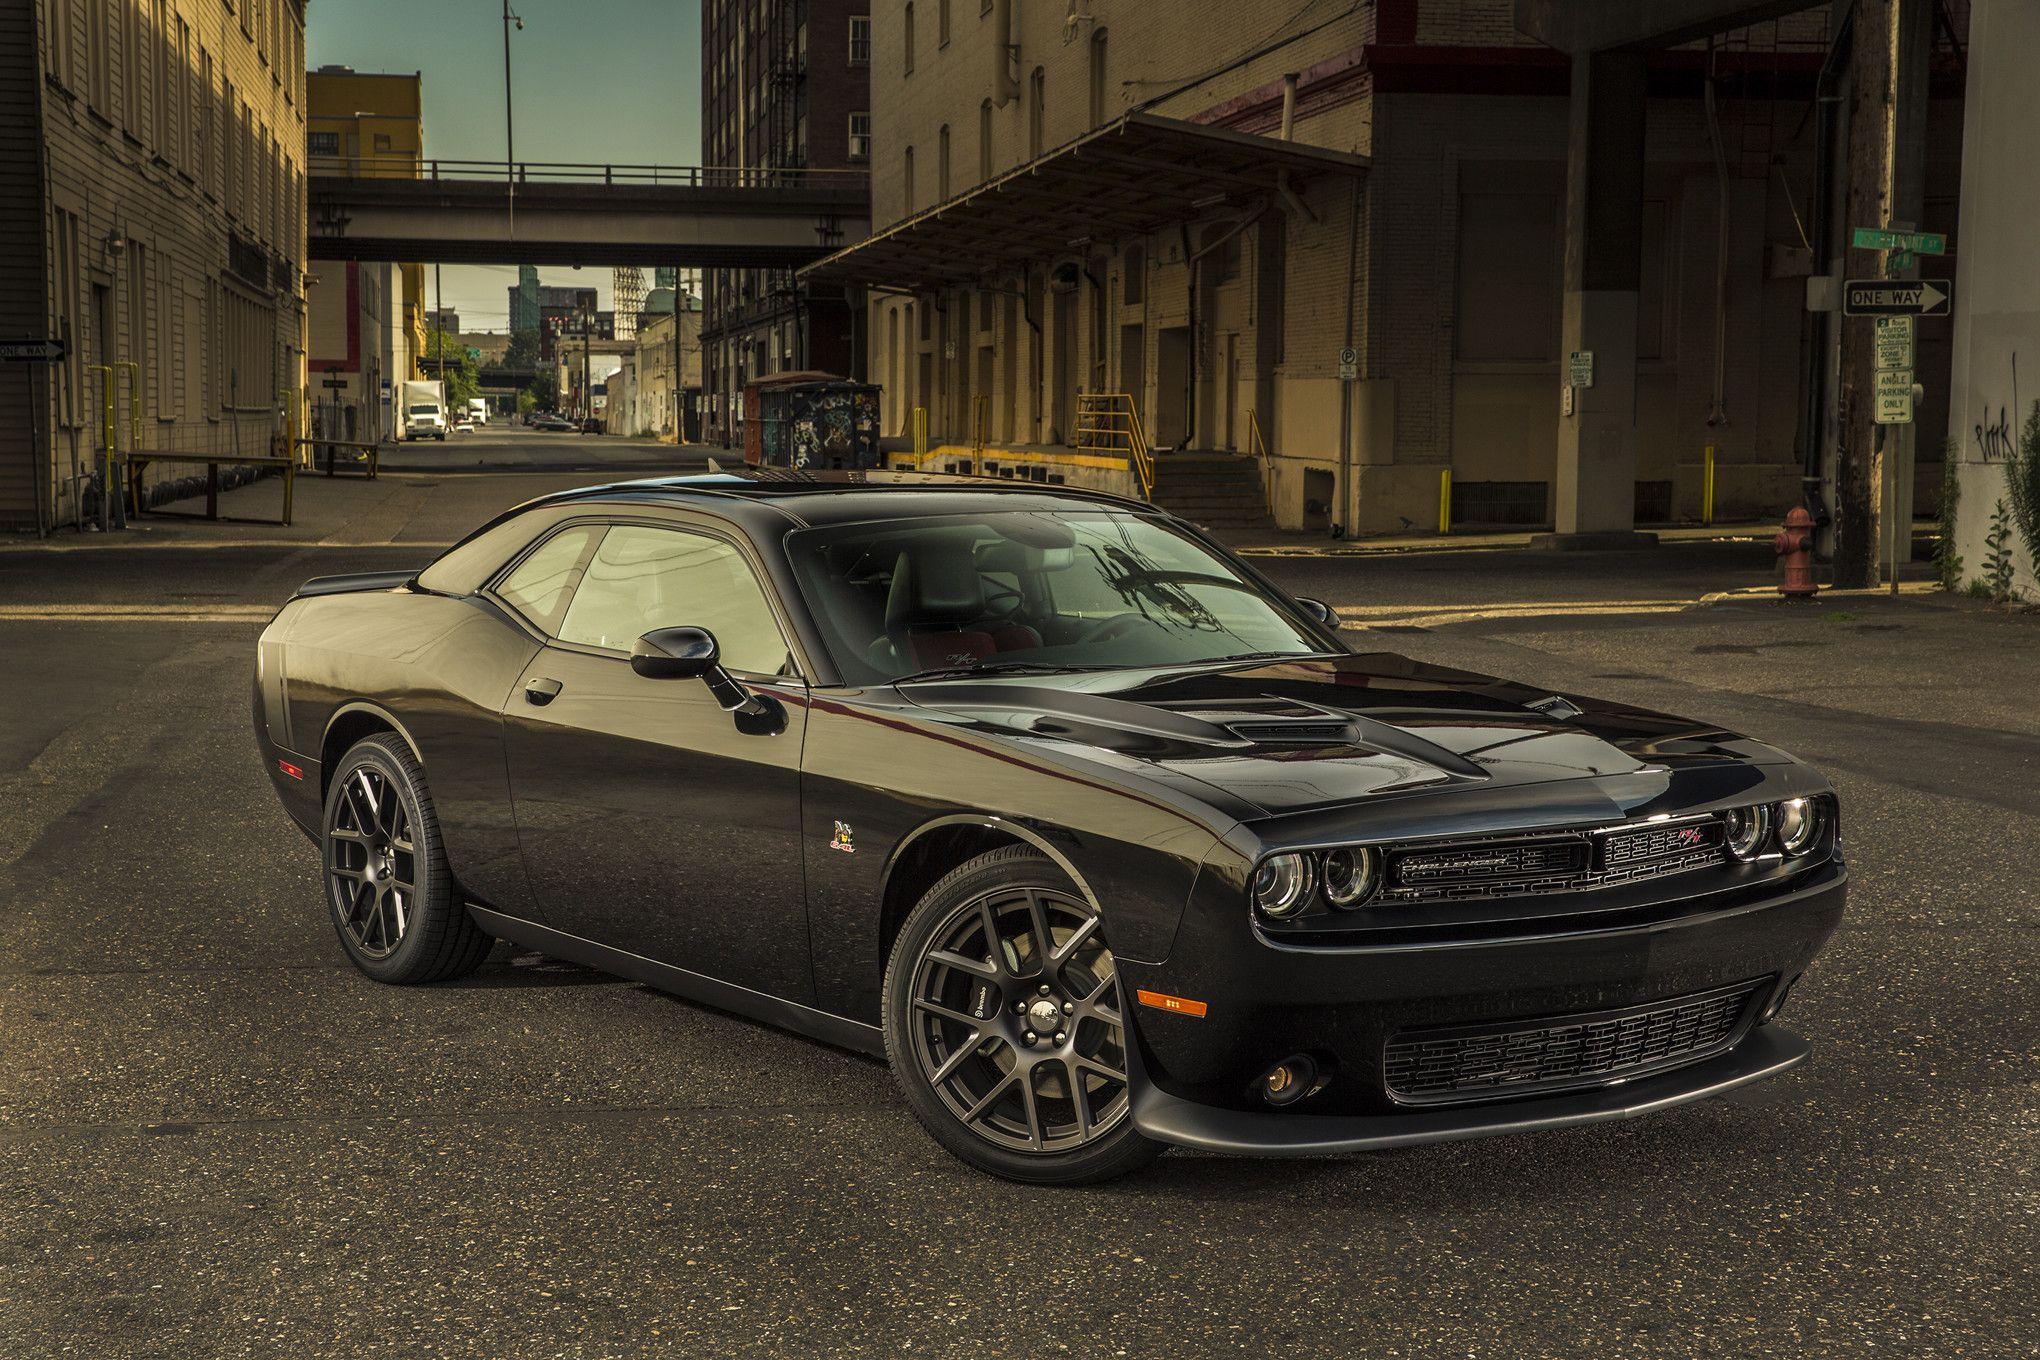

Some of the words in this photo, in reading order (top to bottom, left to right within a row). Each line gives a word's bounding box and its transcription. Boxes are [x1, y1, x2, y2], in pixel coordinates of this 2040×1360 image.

[1853, 291, 1883, 304] ONE
[1892, 291, 1922, 304] WAY
[0, 346, 18, 356] ONE
[26, 346, 47, 355] WAY
[1881, 376, 1905, 384] ANGLE
[1878, 388, 1910, 396] PARKING
[1884, 400, 1904, 409] ONLY
[1678, 826, 1704, 847] R/T
[1402, 858, 1507, 871] CHALLENGER
